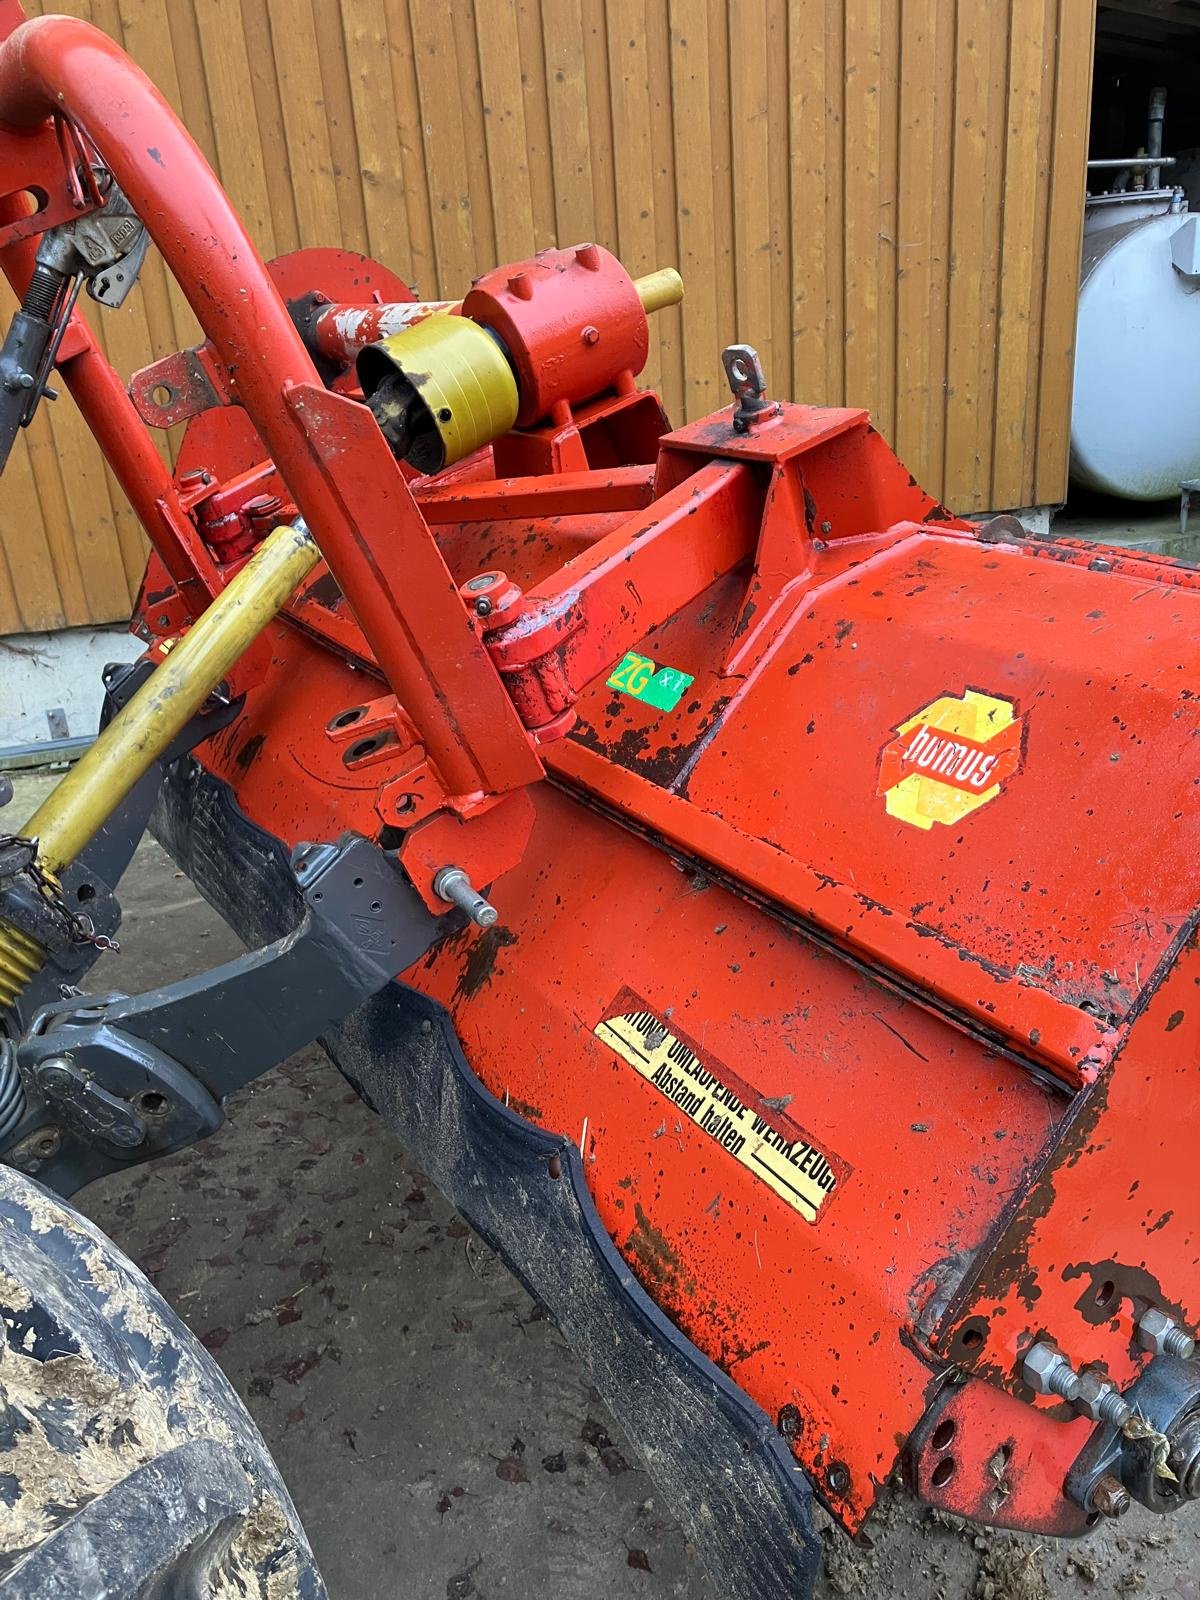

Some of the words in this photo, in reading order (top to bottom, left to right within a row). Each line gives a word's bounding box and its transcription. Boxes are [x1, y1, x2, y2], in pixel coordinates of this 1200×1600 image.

[610, 654, 656, 695] ZG
[903, 724, 999, 787] humus
[650, 1062, 706, 1117] Abstand
[699, 1103, 746, 1156] halten
